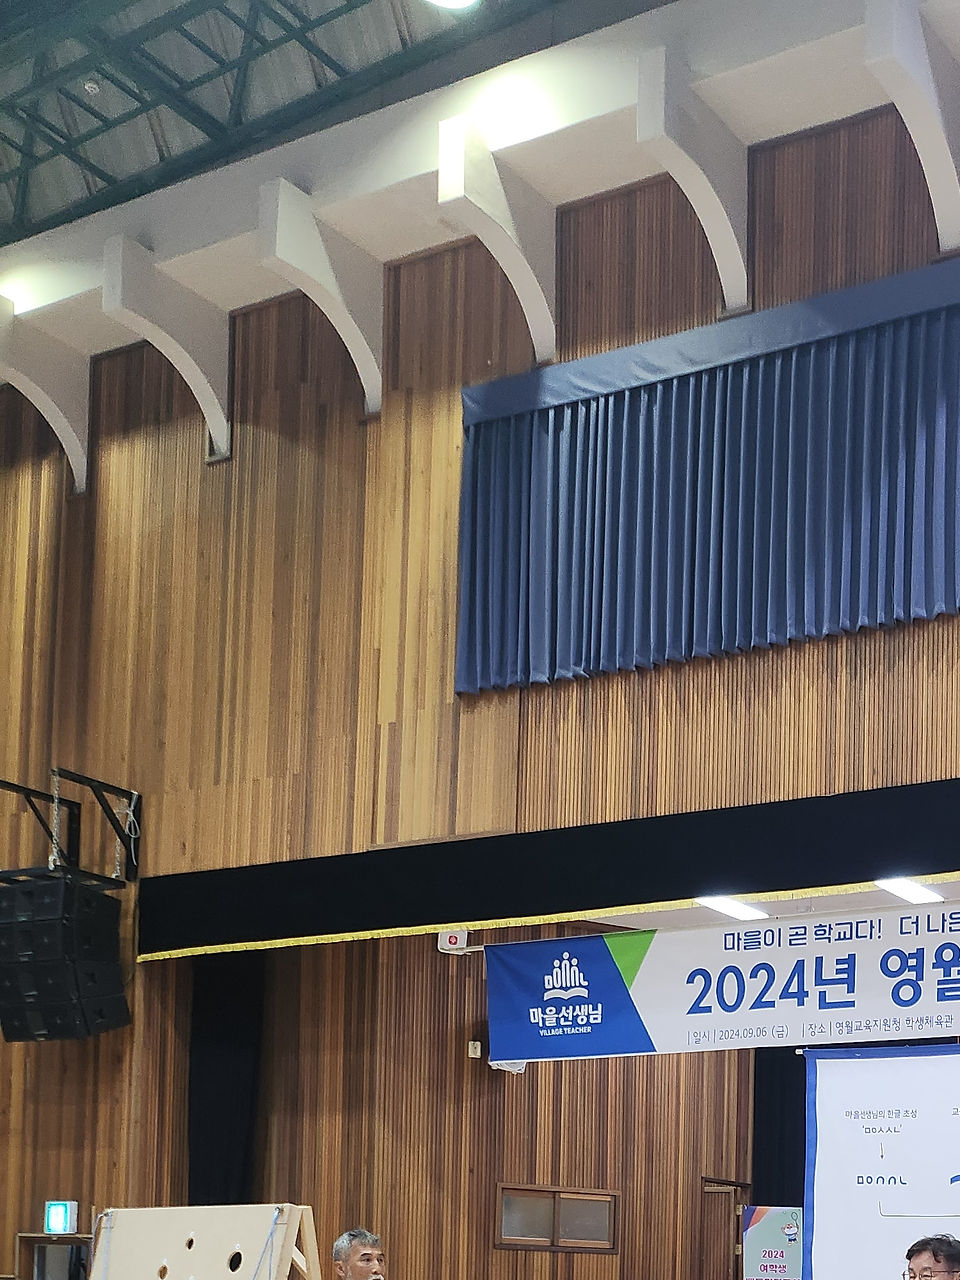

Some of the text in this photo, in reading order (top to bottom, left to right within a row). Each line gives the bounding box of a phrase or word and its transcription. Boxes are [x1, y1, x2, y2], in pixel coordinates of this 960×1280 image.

[724, 928, 782, 951] 마을이
[788, 926, 807, 946] 곧
[814, 919, 882, 943] 학교다!
[900, 916, 919, 936] 더
[686, 953, 856, 1015] 2024년
[529, 1003, 602, 1027] 마을선생님
[808, 1014, 954, 1037] 장소 영월교육지원청 학생체육관
[540, 1026, 592, 1037] VILLAGE TEACHER
[693, 1025, 789, 1044] 일시 2024.09.06 (금)
[762, 1250, 785, 1259] 2024
[760, 1263, 787, 1274] 여학생
